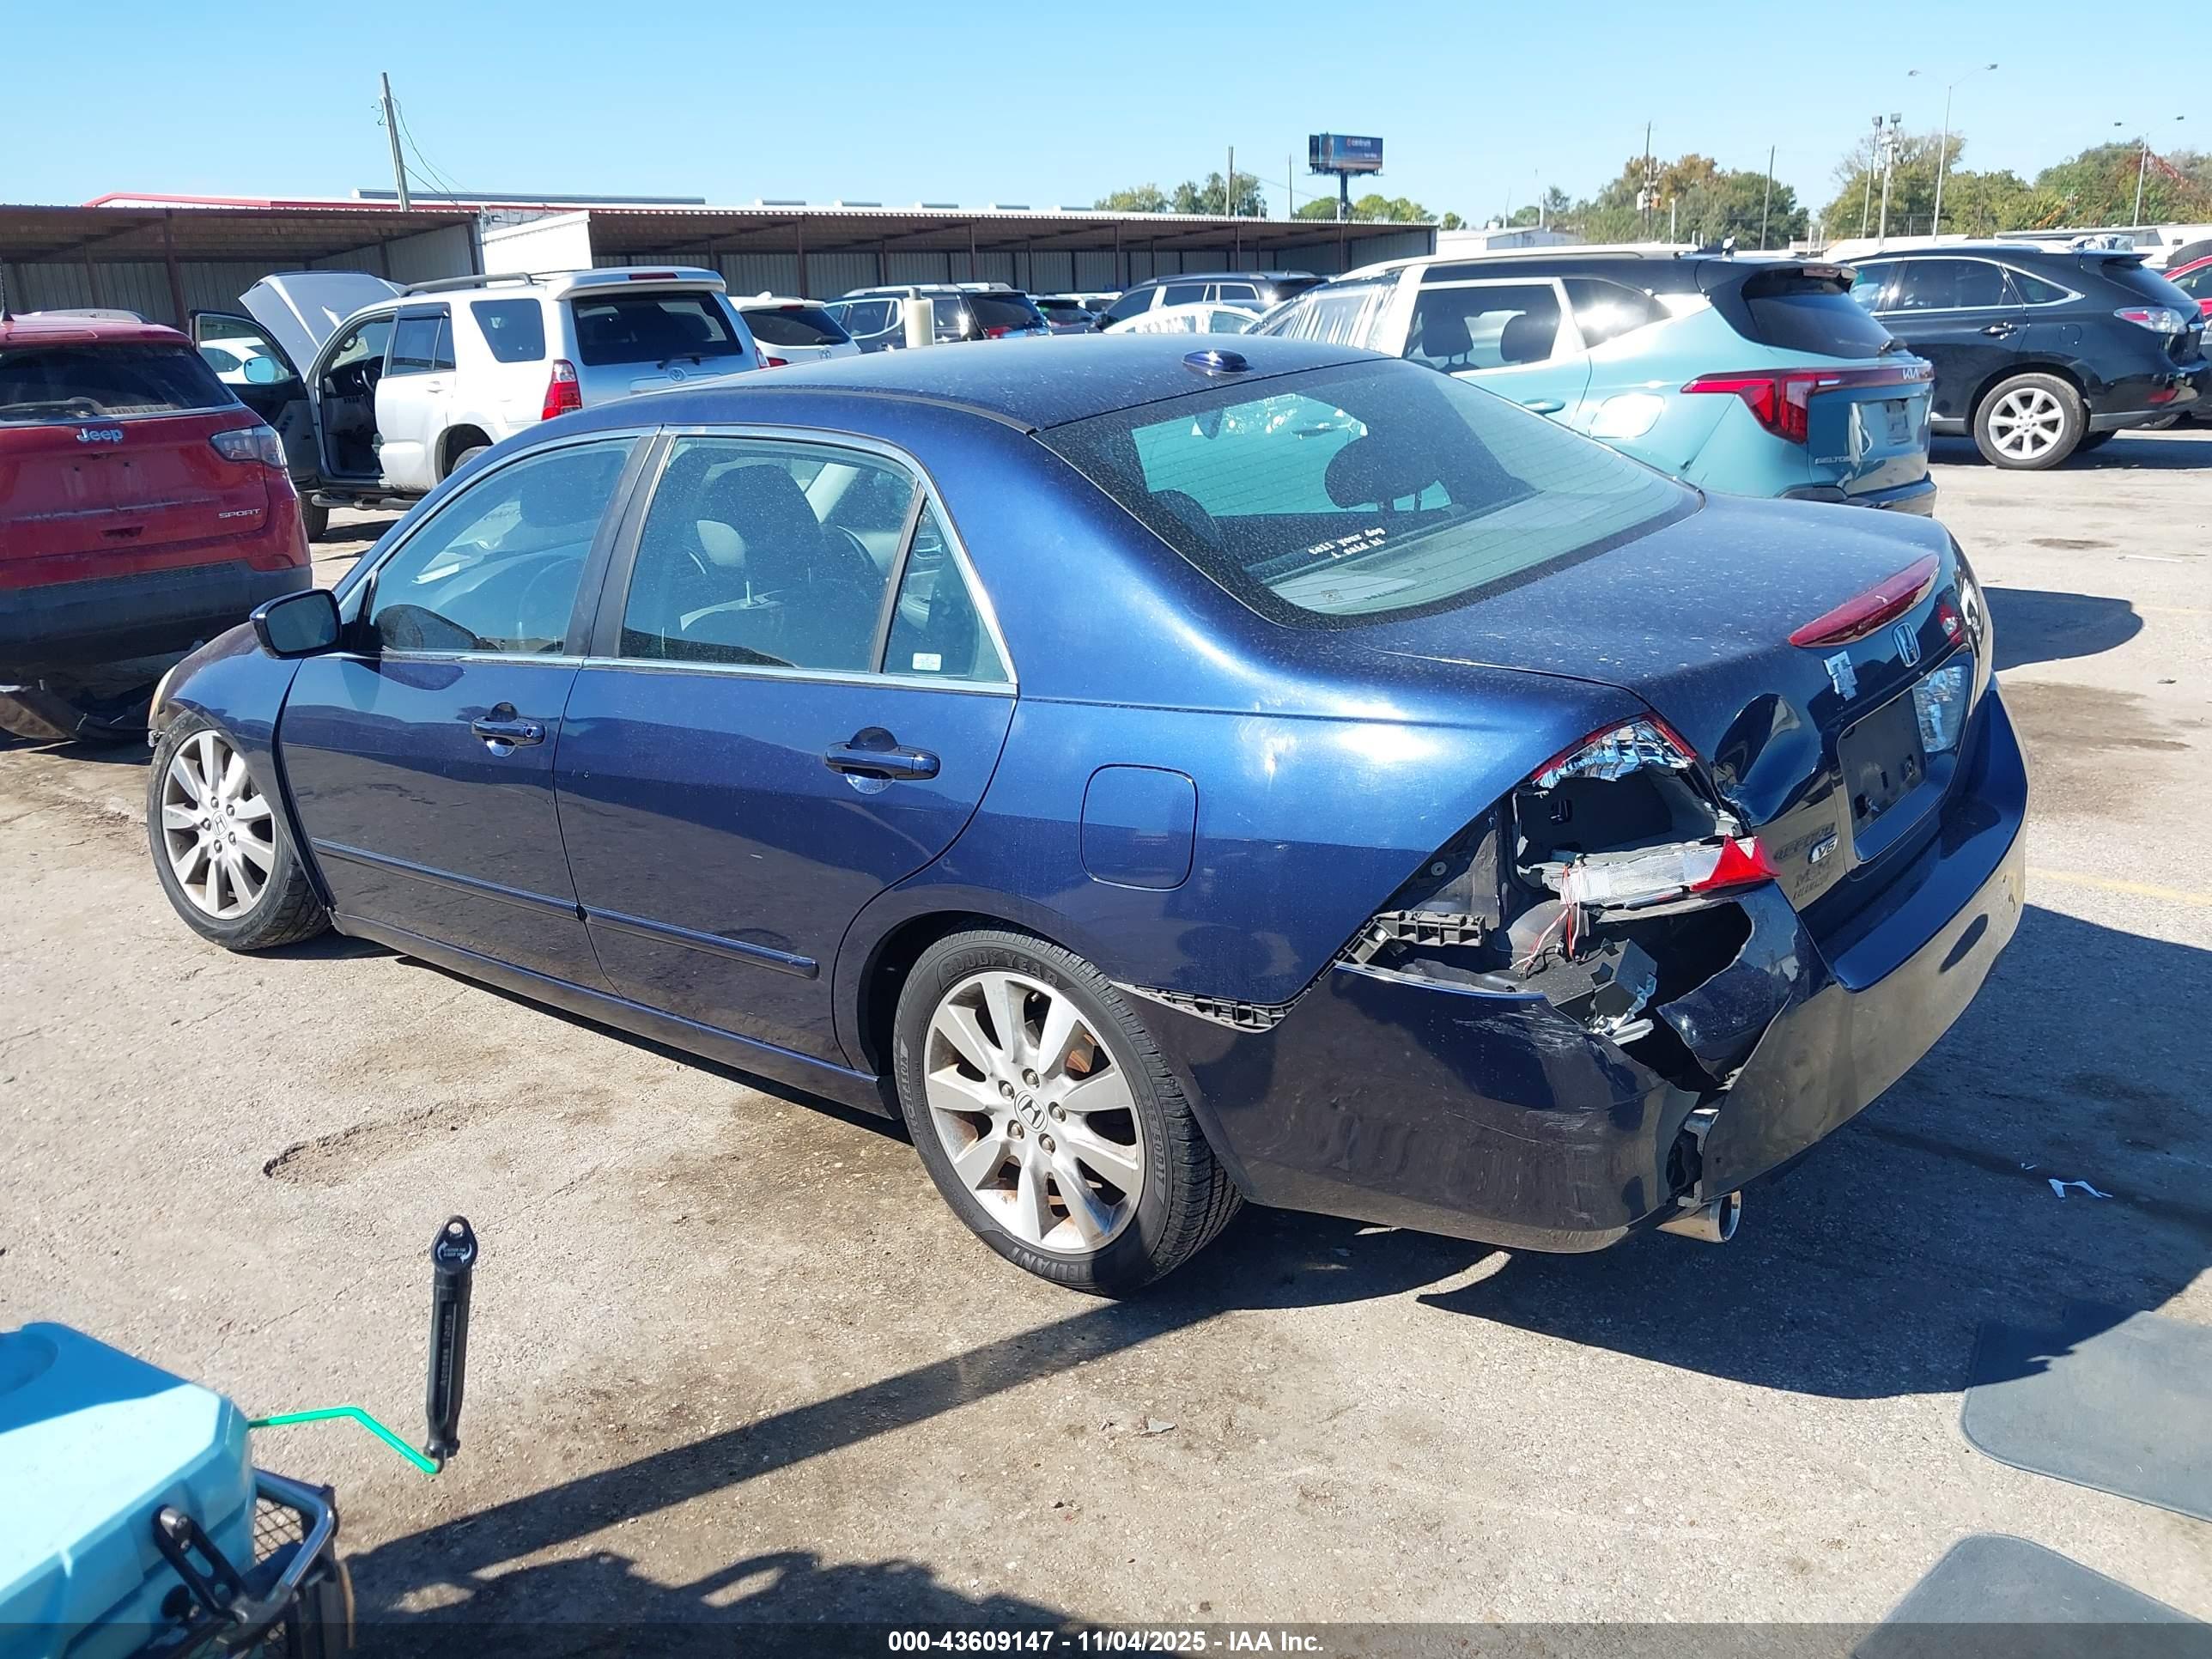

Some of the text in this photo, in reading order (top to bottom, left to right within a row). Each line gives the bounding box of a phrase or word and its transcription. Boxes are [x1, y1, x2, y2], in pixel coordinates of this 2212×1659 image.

[76, 428, 123, 444] Jeep
[218, 507, 260, 519] SPORT
[1308, 527, 1386, 555] tell your dog
[1344, 542, 1370, 555] said
[1817, 841, 1836, 859] V6
[440, 1314, 453, 1387] Access Tools
